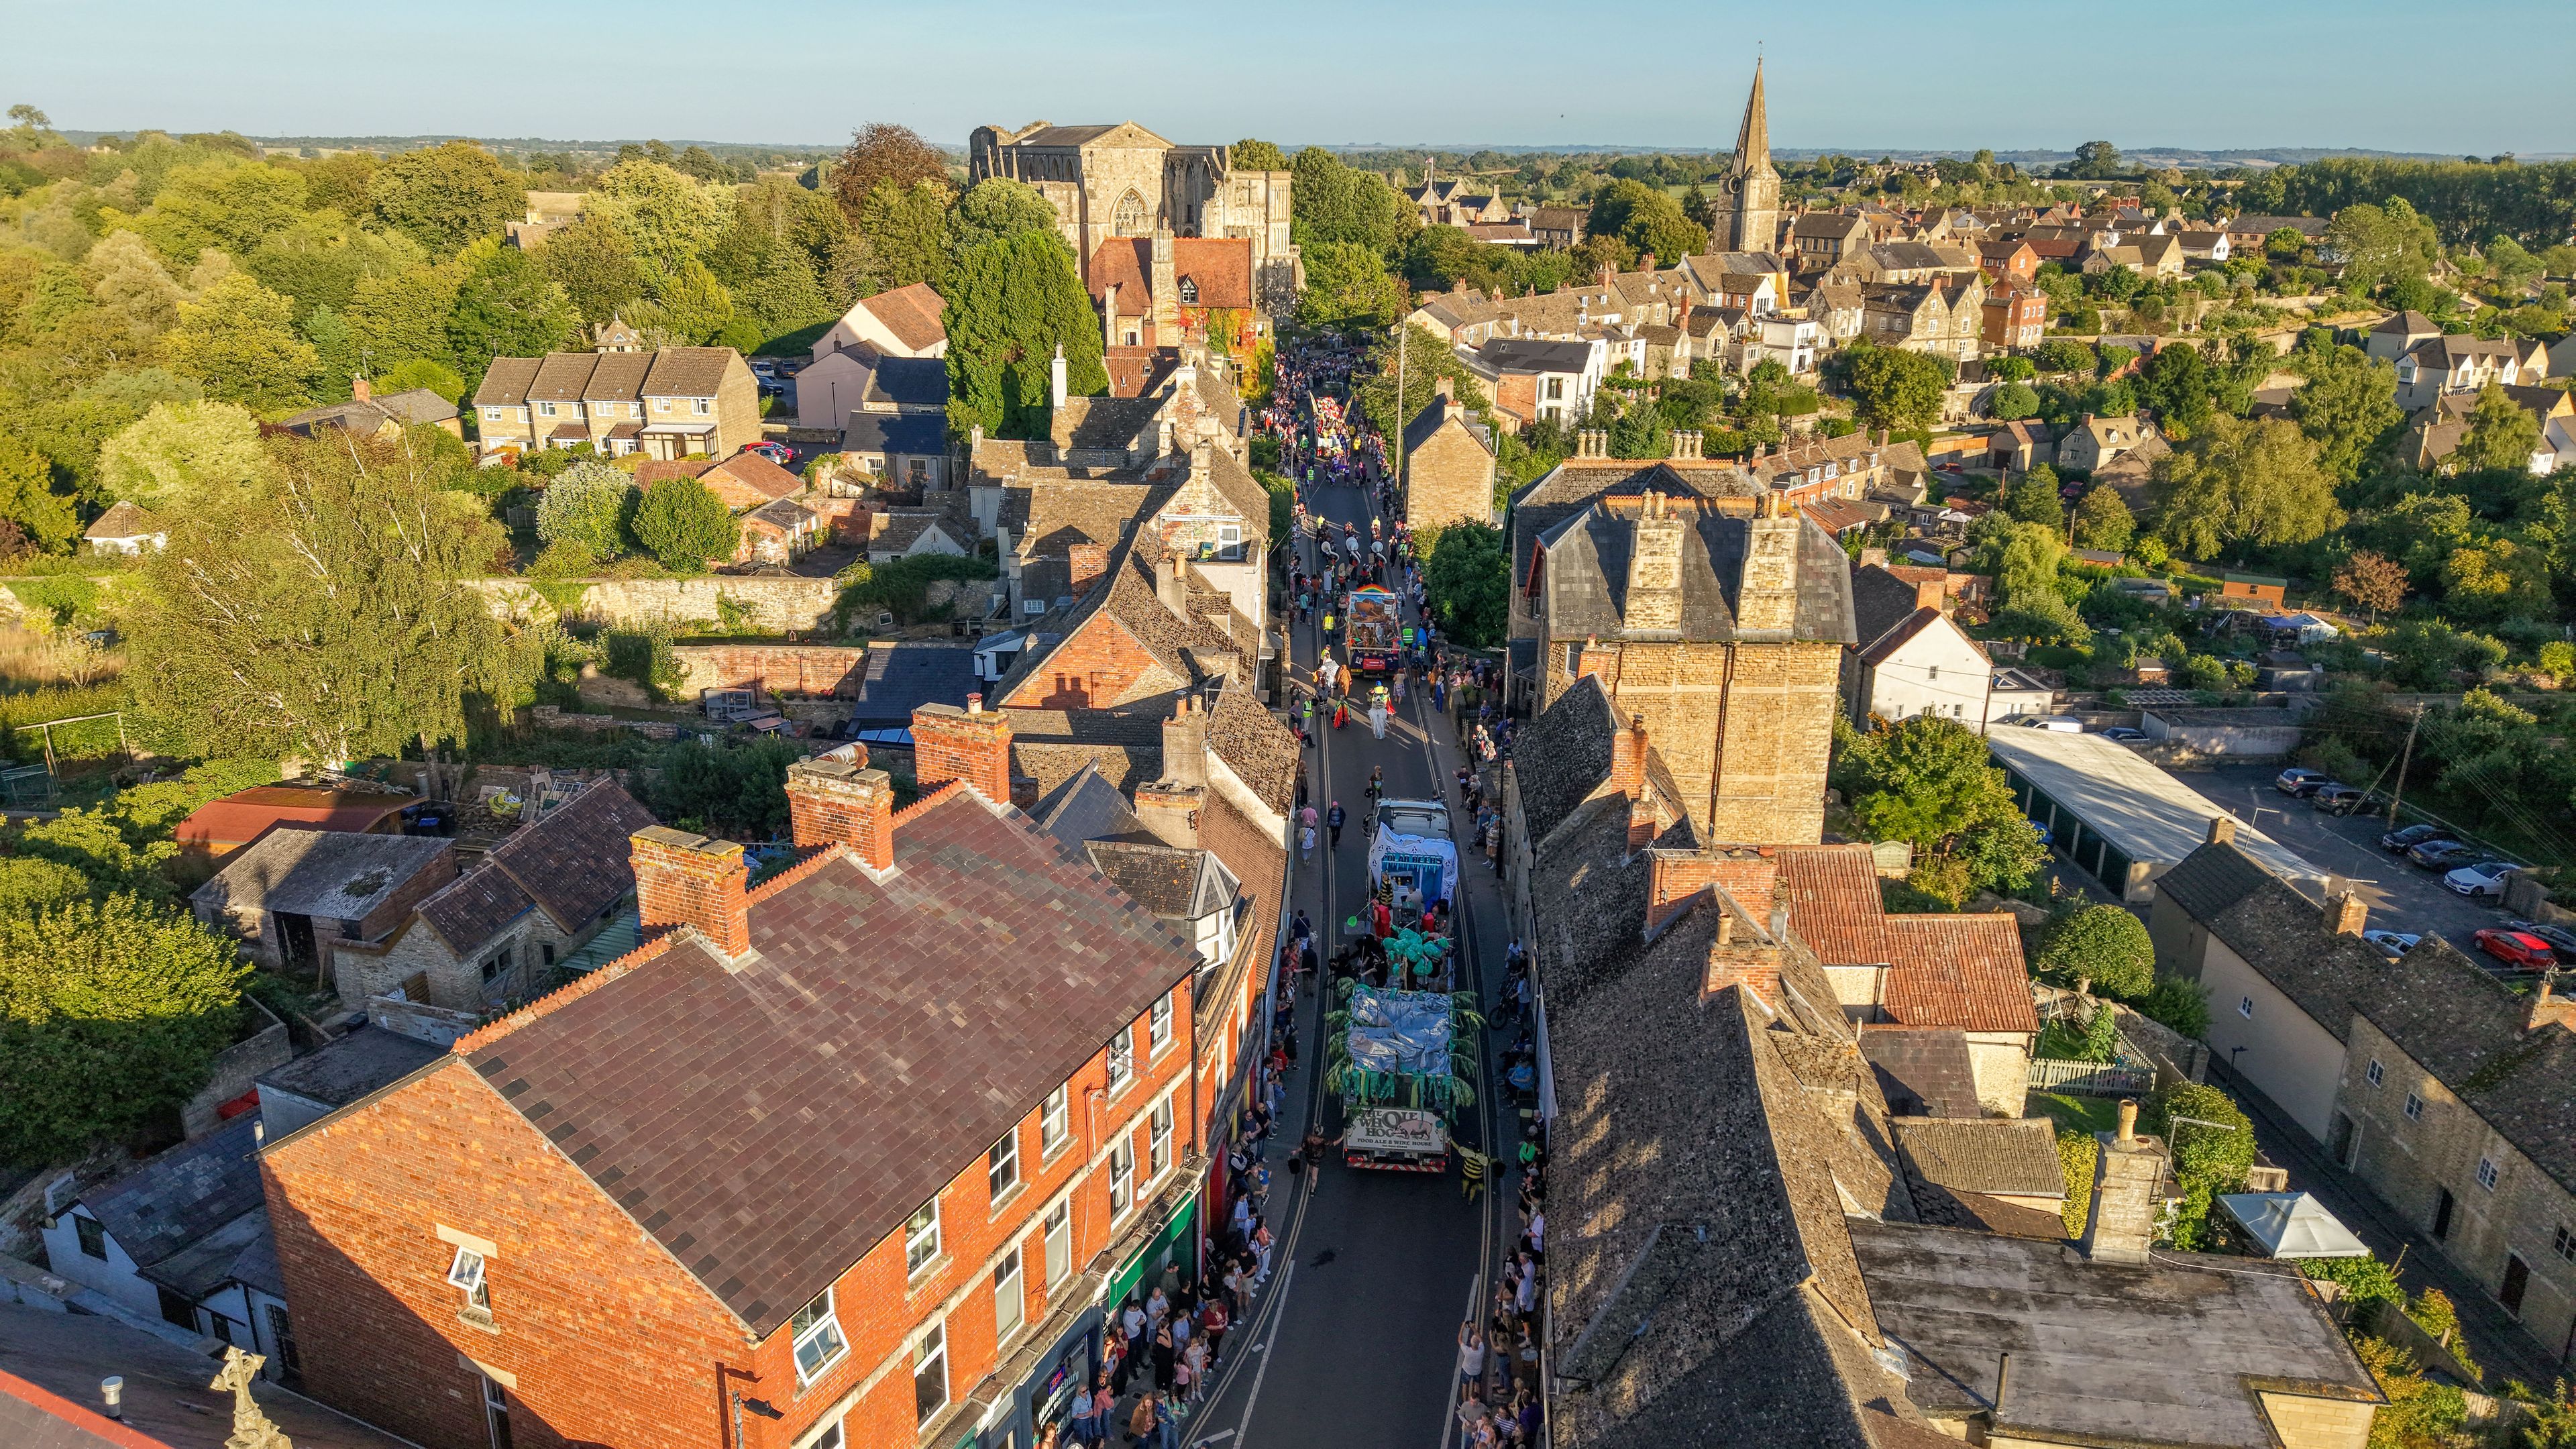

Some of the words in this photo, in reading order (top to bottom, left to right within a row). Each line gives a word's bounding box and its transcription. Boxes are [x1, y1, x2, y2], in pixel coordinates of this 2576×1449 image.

[1383, 854, 1409, 862] POLAR
[1412, 855, 1443, 865] BEERS
[1358, 1111, 1417, 1129] WHOLE
[1365, 1128, 1395, 1138] HOG
[1038, 1371, 1079, 1425] Malmesbury
